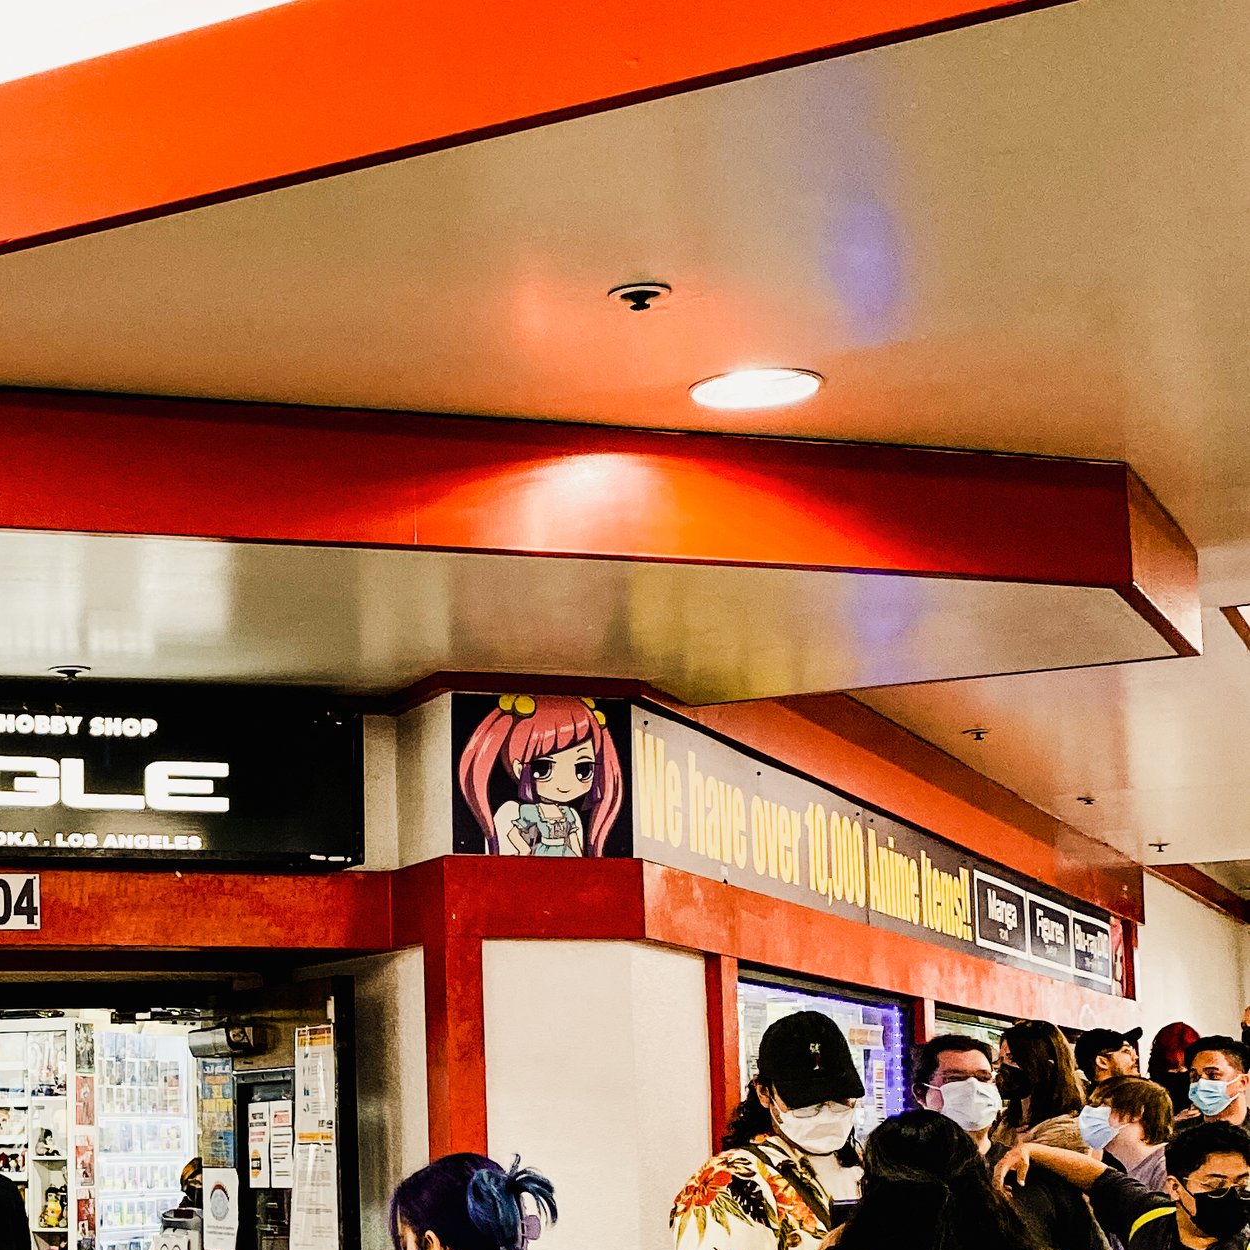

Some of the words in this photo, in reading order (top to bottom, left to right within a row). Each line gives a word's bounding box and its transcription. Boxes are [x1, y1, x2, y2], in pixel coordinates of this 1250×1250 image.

[89, 717, 158, 738] SHOP
[56, 832, 98, 848] LOS
[102, 833, 202, 849] ANGELES
[635, 728, 682, 848] We
[688, 750, 747, 869] have
[751, 795, 800, 886] over
[805, 802, 865, 907] 10,000
[868, 828, 919, 925] Anime
[921, 850, 973, 941] Items!!
[987, 888, 1018, 930] Manga
